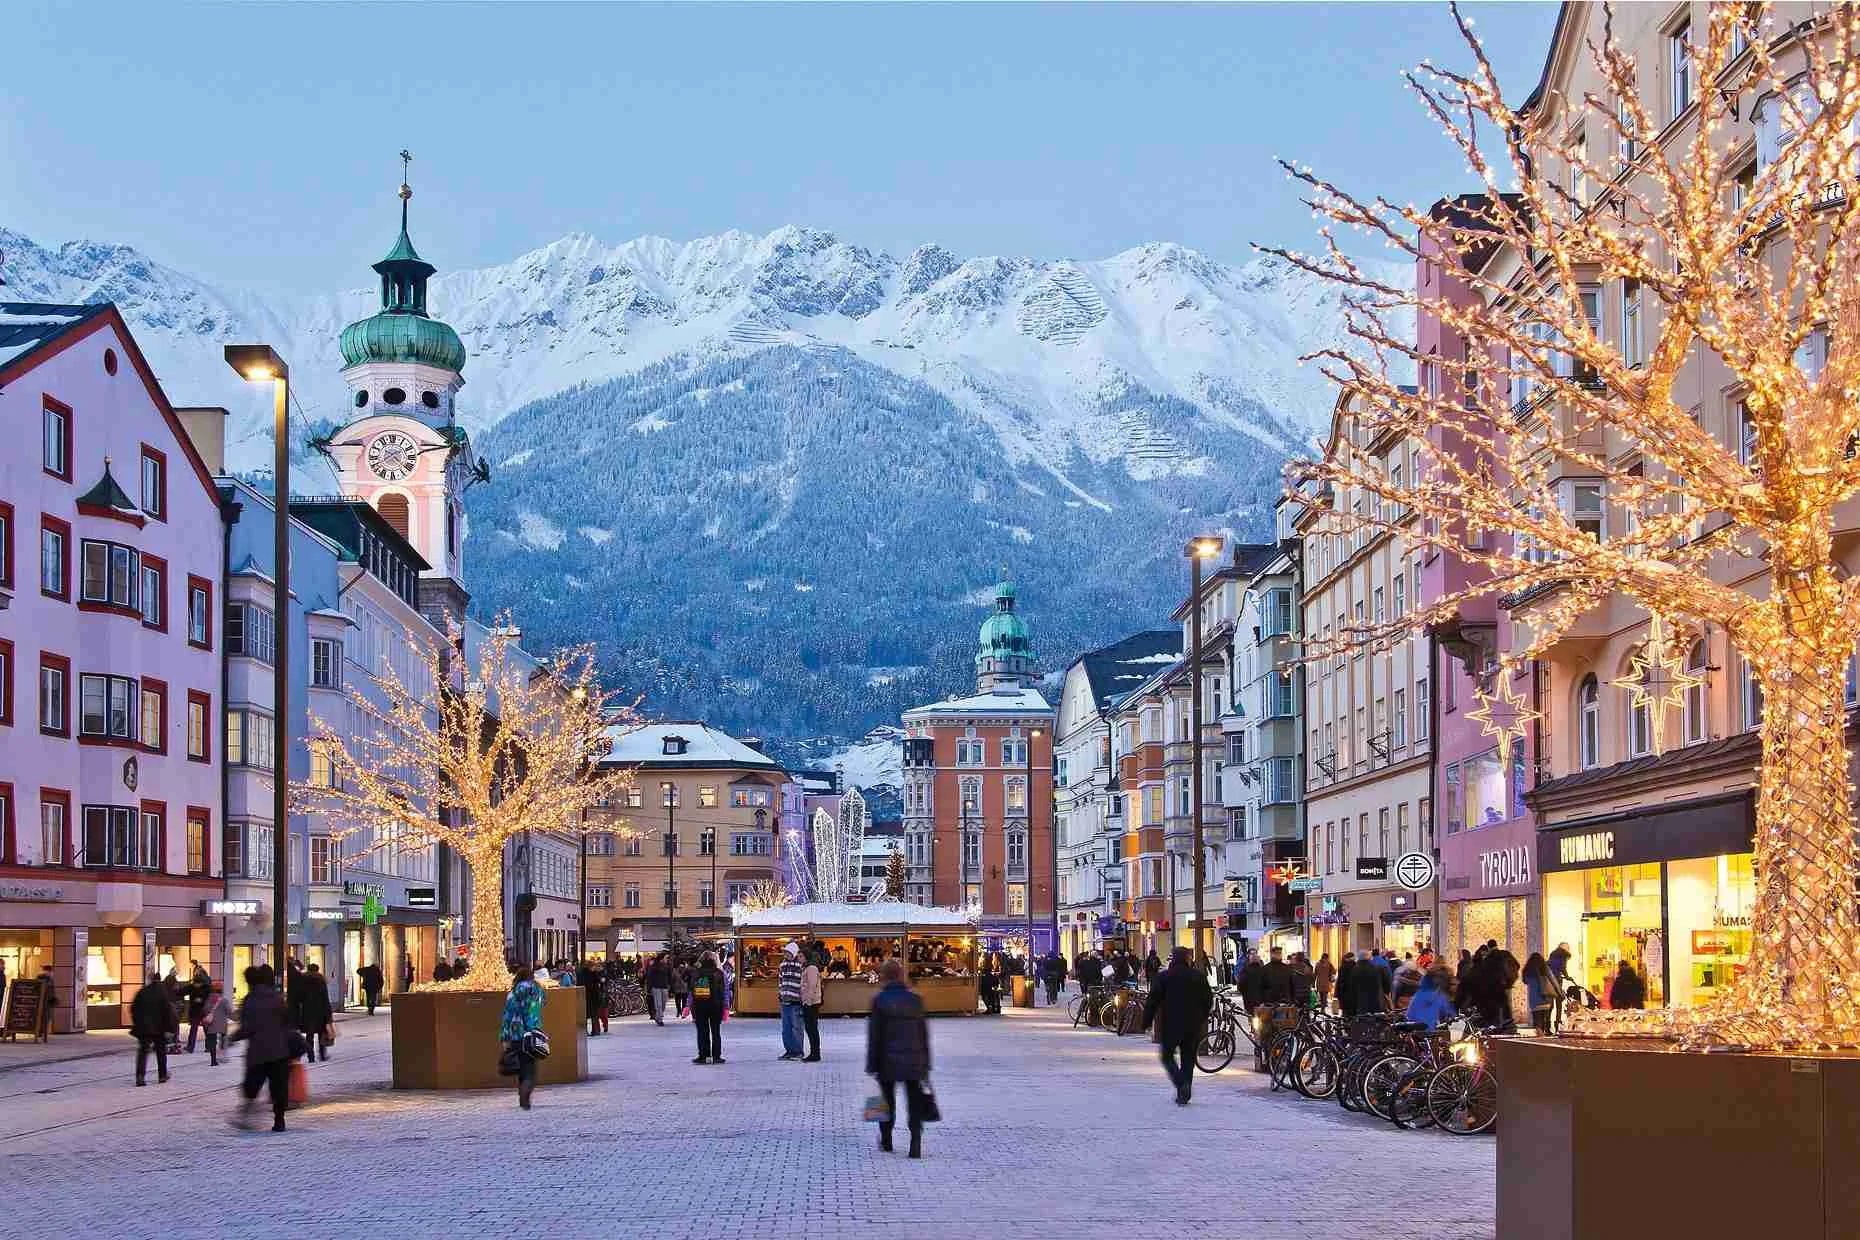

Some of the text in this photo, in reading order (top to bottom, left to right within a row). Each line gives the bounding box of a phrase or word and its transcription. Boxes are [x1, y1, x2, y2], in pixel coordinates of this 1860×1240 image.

[1560, 831, 1614, 864] HUMANIC
[1359, 867, 1384, 876] BONITA
[1479, 845, 1531, 888] TYROLIA
